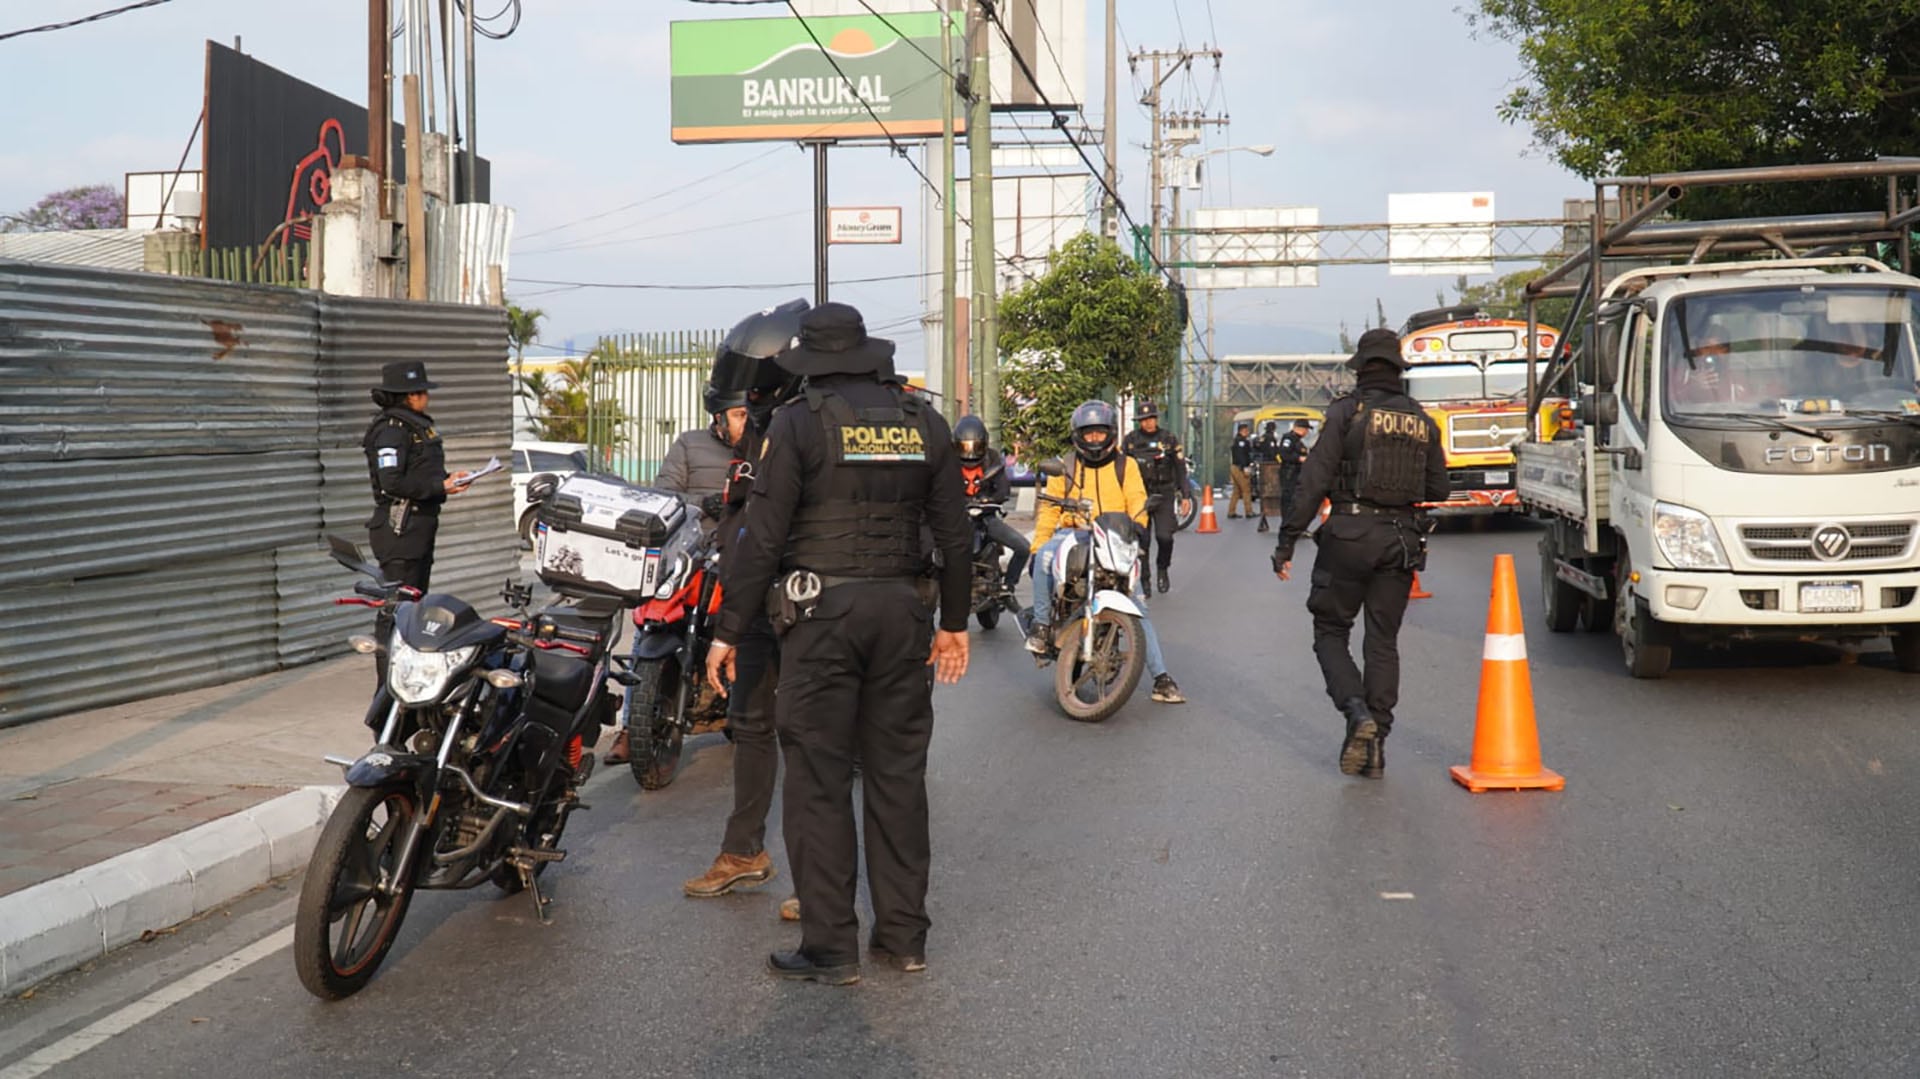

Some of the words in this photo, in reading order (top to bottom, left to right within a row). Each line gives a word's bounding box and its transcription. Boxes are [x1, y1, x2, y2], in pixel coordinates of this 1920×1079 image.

[743, 75, 889, 106] BANRURAL
[742, 109, 752, 118] El
[754, 108, 784, 118] amigo
[786, 107, 805, 118] que
[807, 107, 818, 116] te
[820, 106, 849, 117] ayuda
[851, 106, 859, 114] a
[841, 426, 924, 445] POLICIA
[1373, 412, 1426, 440] POLICIA
[844, 444, 897, 454] NACIONAL
[899, 444, 925, 454] CIVIL
[1765, 443, 1891, 464] FOTON
